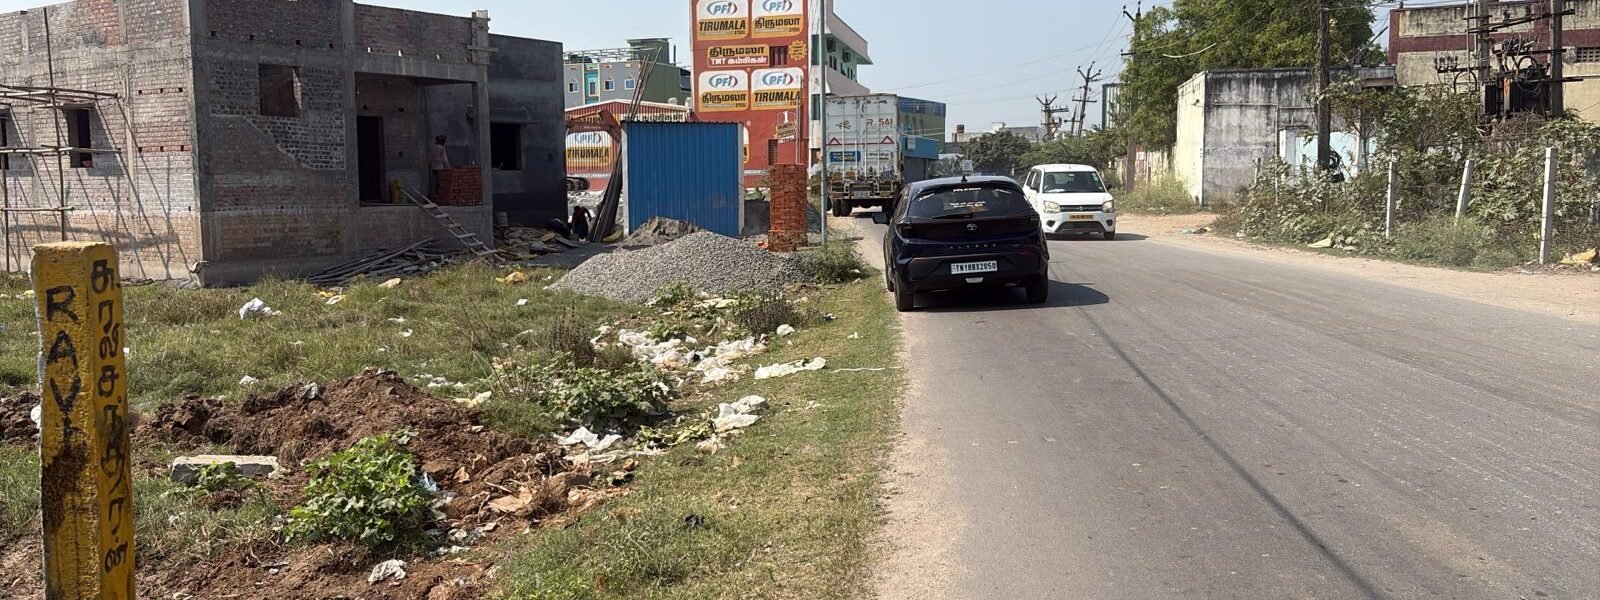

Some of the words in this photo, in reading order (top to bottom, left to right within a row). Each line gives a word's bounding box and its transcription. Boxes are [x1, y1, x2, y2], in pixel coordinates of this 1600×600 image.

[699, 20, 746, 32] TIRUMALA
[754, 17, 801, 29] திருமலா
[709, 46, 765, 57] திருமலா
[727, 57, 767, 65] கம்பிகள்
[702, 92, 747, 104] திருமலா
[754, 91, 801, 103] TIRUMALA
